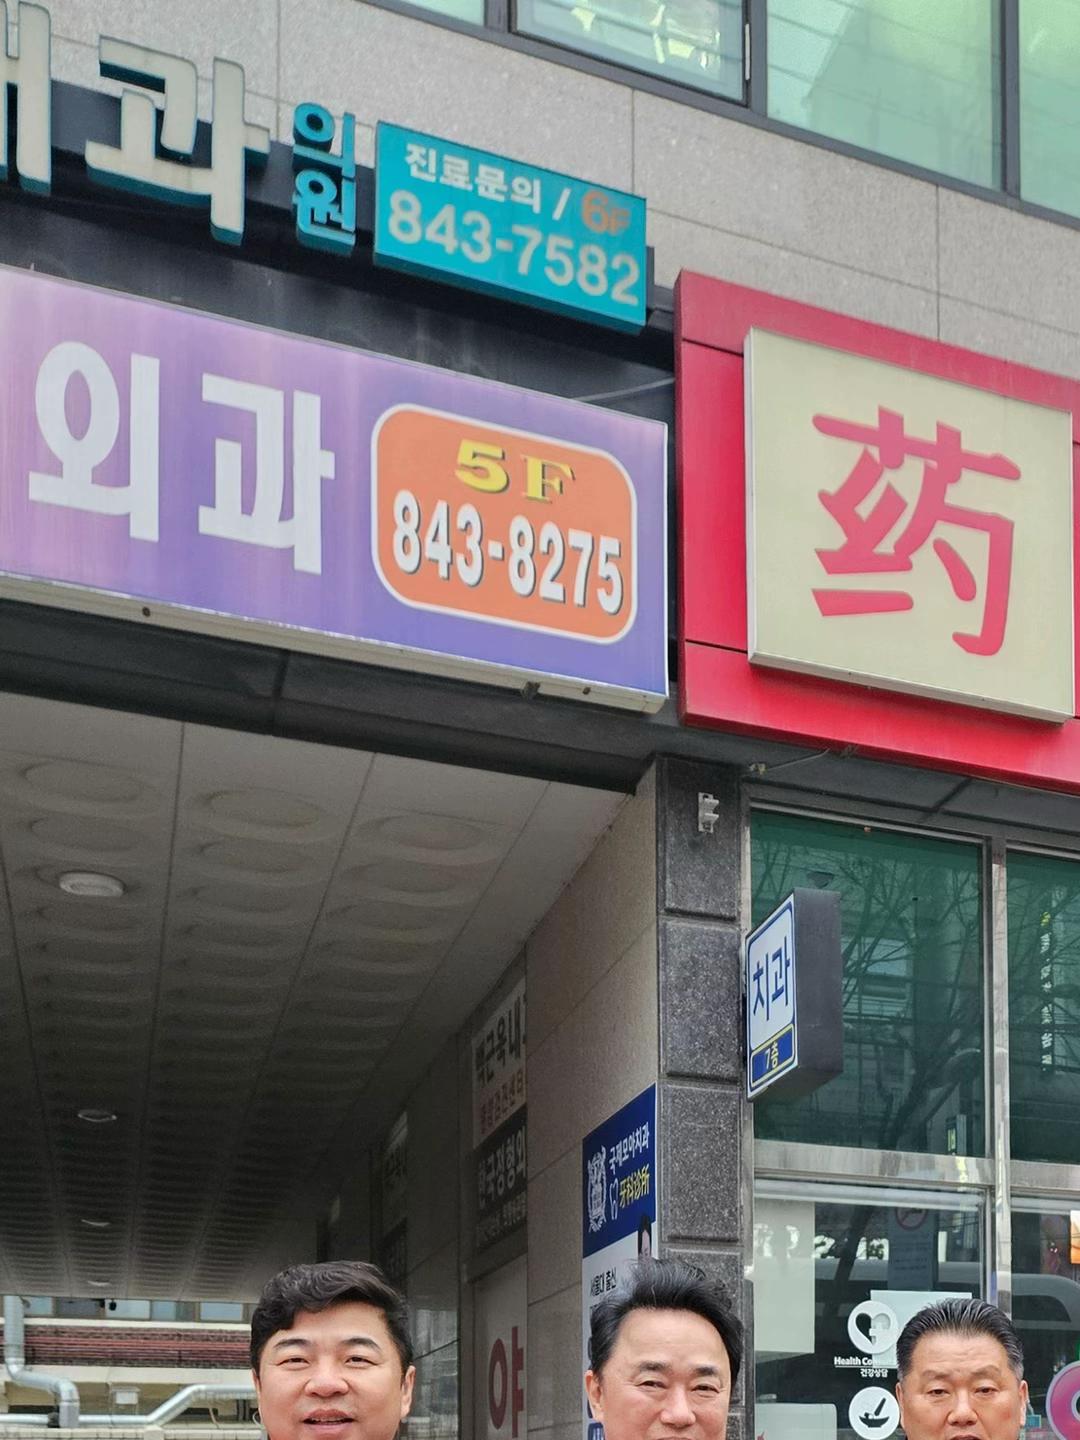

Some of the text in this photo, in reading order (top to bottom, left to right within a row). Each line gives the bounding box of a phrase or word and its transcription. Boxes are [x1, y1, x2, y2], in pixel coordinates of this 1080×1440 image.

[292, 103, 356, 251] 의원
[404, 141, 543, 208] 진료문의
[387, 190, 640, 306] 843-7582
[28, 341, 336, 575] 외과
[392, 489, 625, 616] 843-8275
[811, 405, 1022, 657] 药
[753, 935, 791, 1022] 치과
[764, 1041, 779, 1070] 7층
[608, 1121, 650, 1175] 국제모아치과
[834, 1356, 862, 1366] Health
